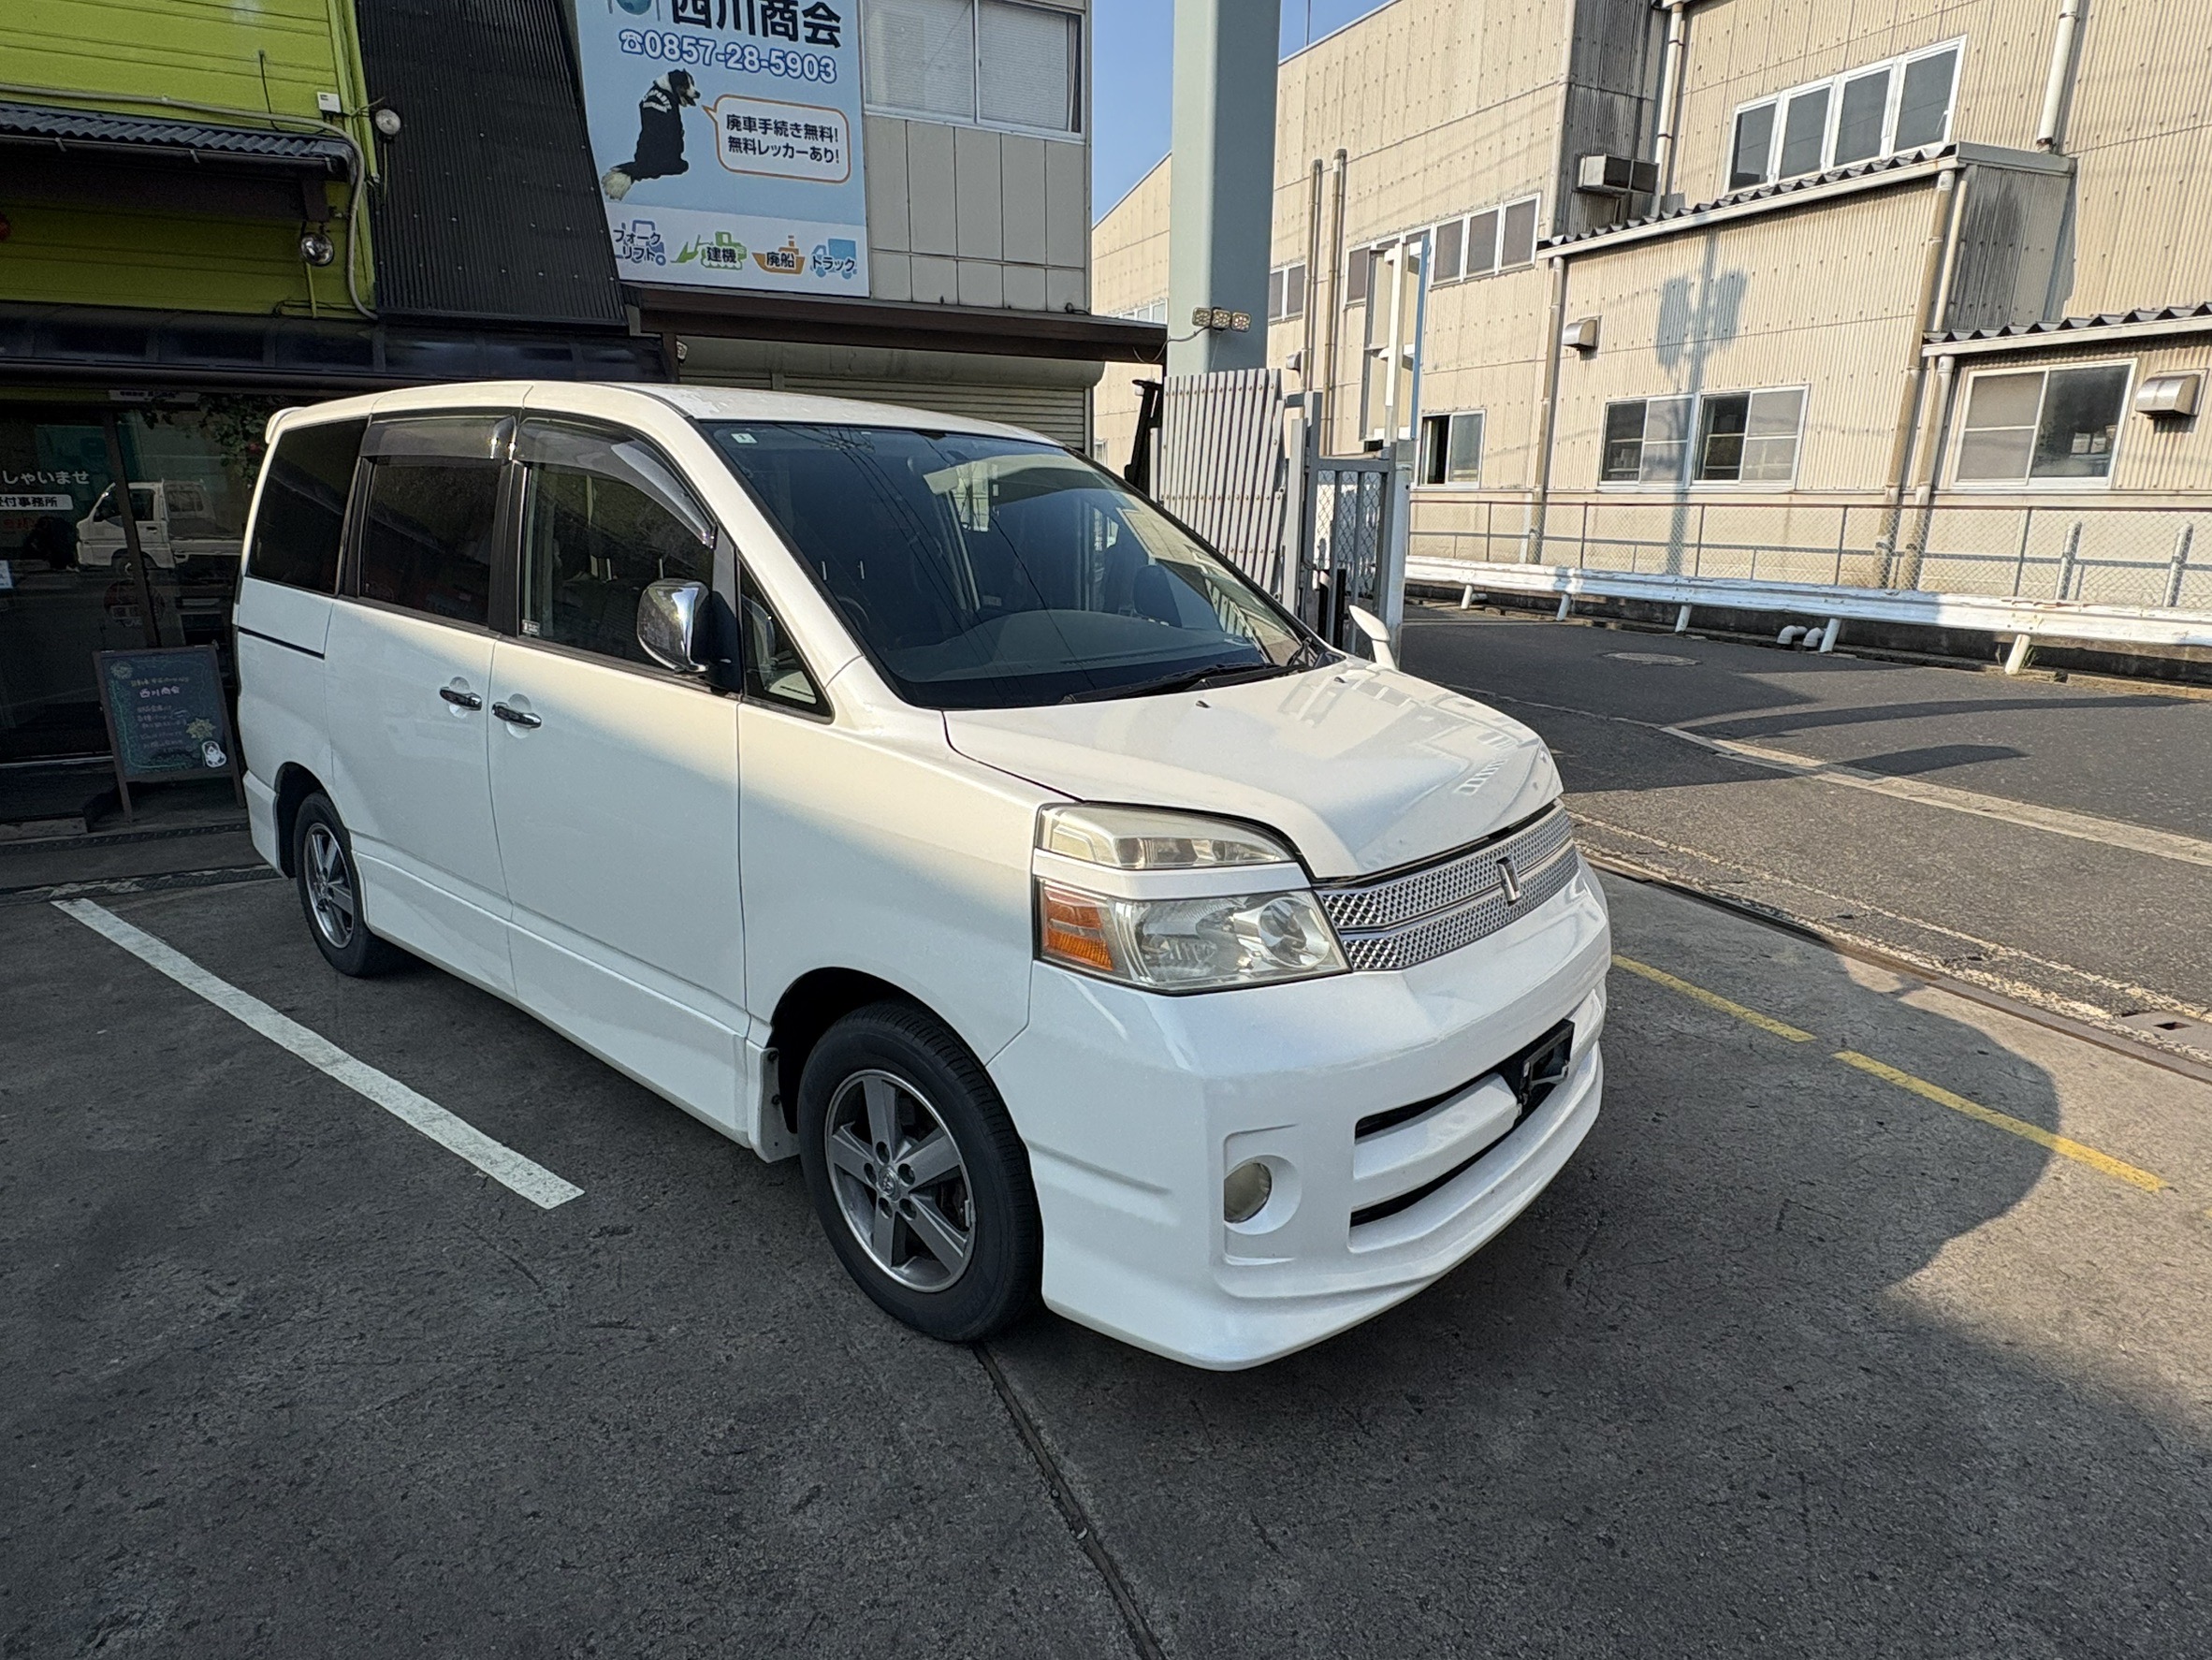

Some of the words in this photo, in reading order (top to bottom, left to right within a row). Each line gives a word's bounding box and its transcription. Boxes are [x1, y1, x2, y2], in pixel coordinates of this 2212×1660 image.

[644, 29, 837, 84] 0857-28-5903
[726, 114, 838, 143] 廃車手続き無料!
[728, 136, 839, 164] 無料レッカーあり!
[613, 228, 661, 244] フォーク
[622, 247, 656, 261] リフト
[706, 247, 738, 264] 建機
[766, 252, 795, 269] 廃船
[812, 255, 855, 272] トラック
[0, 496, 58, 507] 付事務所
